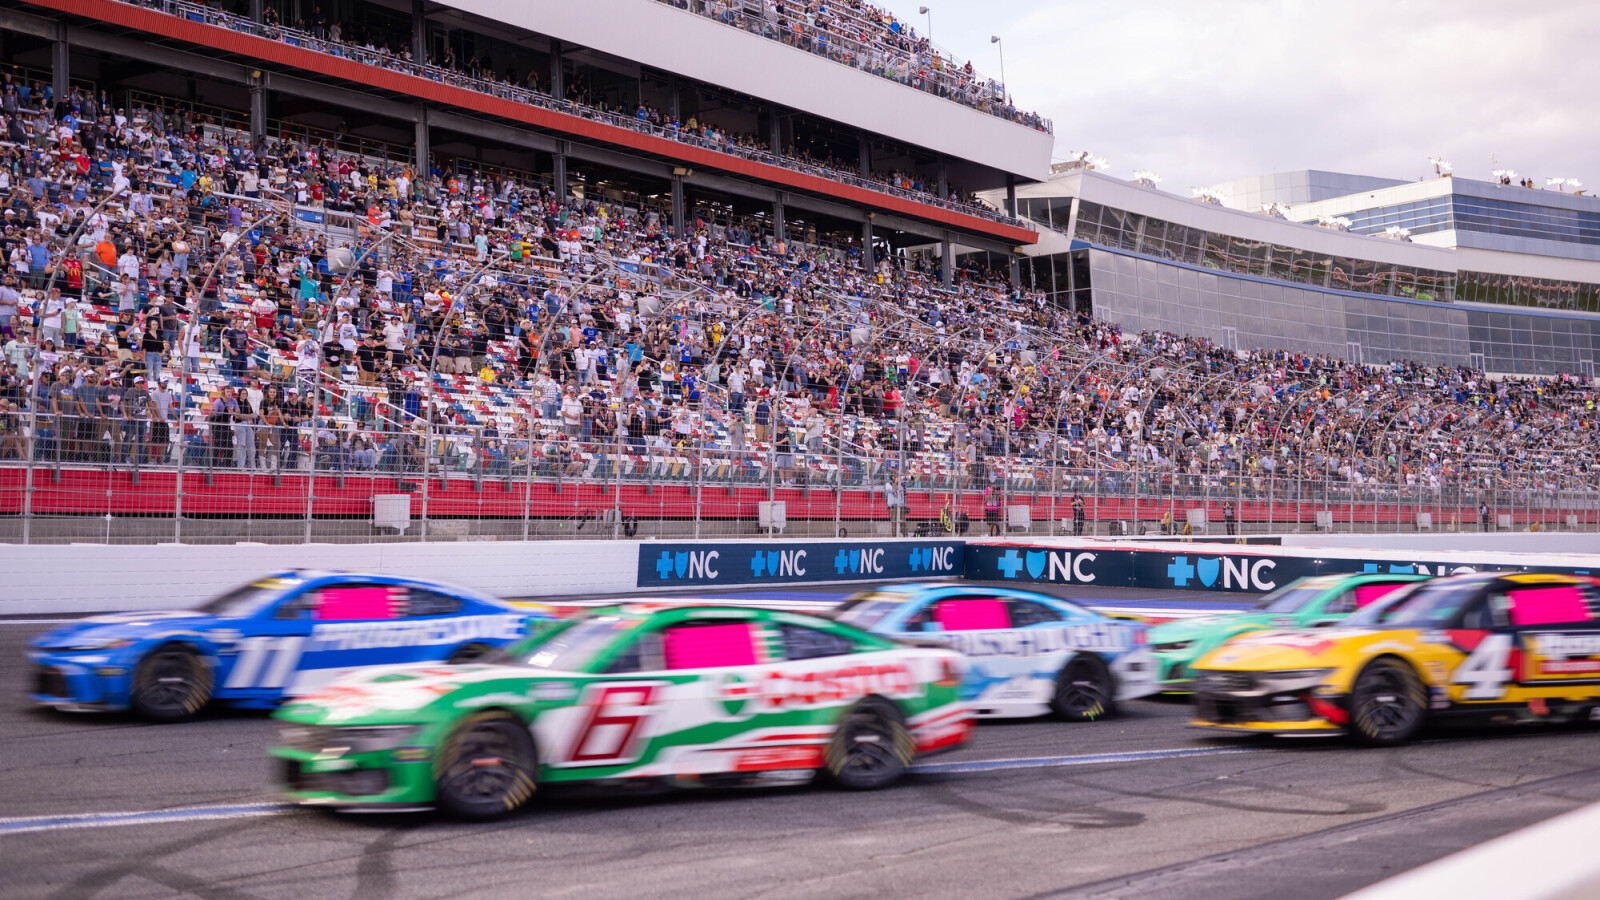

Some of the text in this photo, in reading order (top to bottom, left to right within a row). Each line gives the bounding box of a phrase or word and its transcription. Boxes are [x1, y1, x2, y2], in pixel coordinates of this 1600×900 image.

[688, 550, 720, 579] NC
[780, 550, 807, 577] NC
[861, 548, 885, 574] NC
[932, 547, 955, 571] NC
[1048, 552, 1097, 583] NC
[1222, 556, 1277, 591] NC
[223, 636, 307, 688] 11
[1453, 633, 1514, 699] 4
[567, 686, 657, 762] 6
